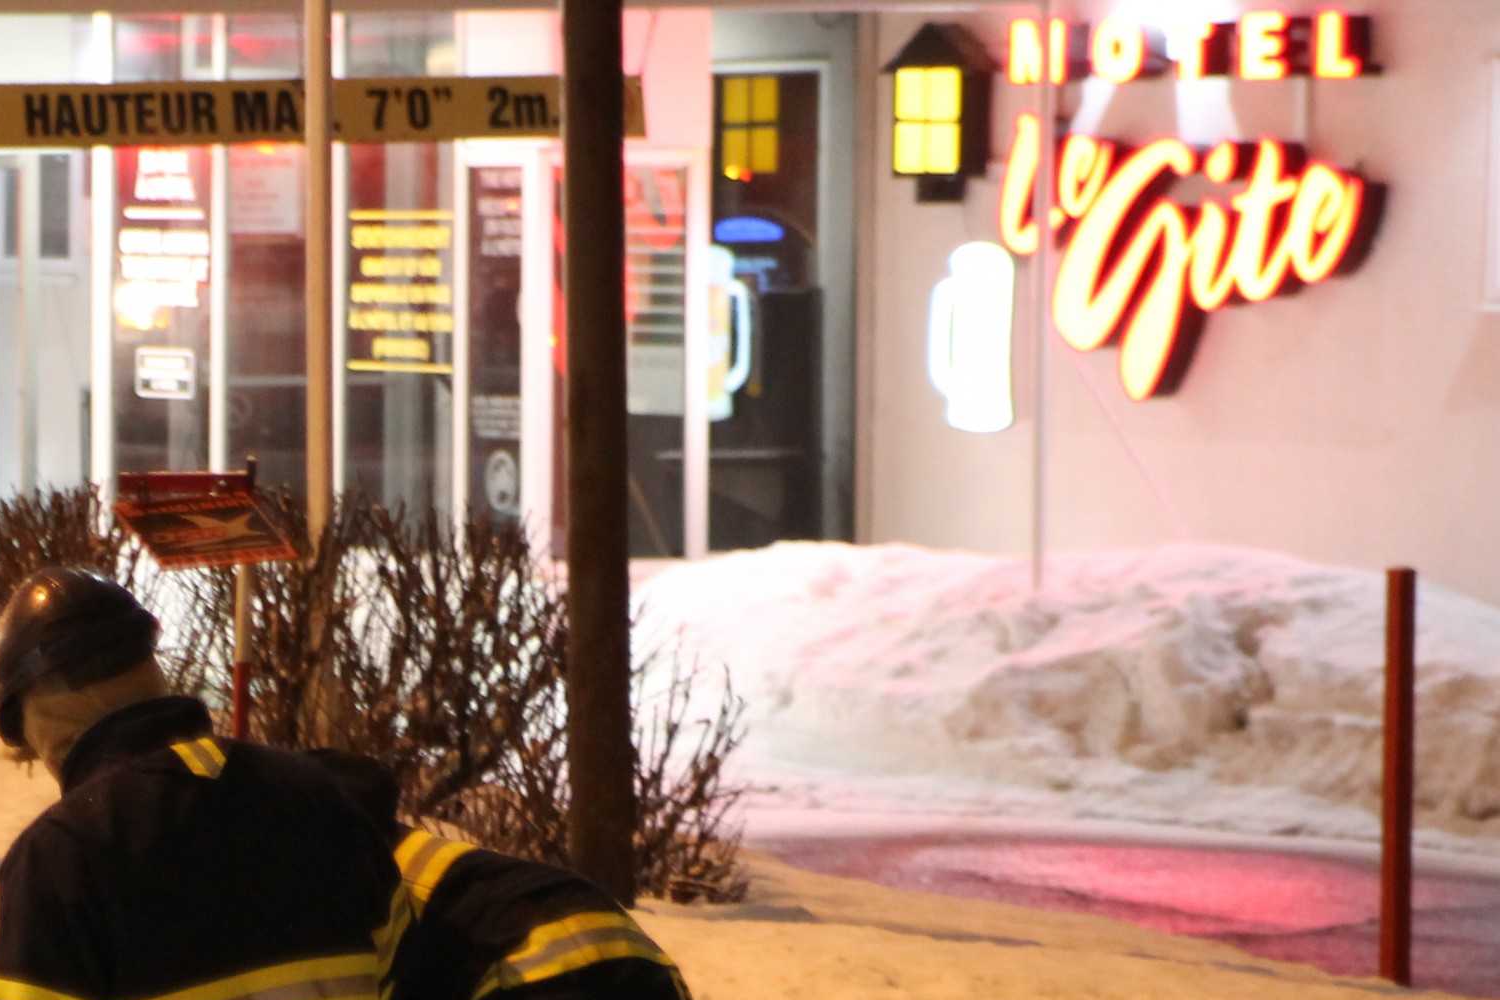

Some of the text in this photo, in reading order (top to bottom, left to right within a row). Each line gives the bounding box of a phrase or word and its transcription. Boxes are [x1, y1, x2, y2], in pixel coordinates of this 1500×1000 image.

[1006, 10, 1362, 84] MOTEL
[22, 89, 218, 138] HAUTEUR
[231, 86, 341, 134] MA.
[1000, 112, 1114, 256] Le
